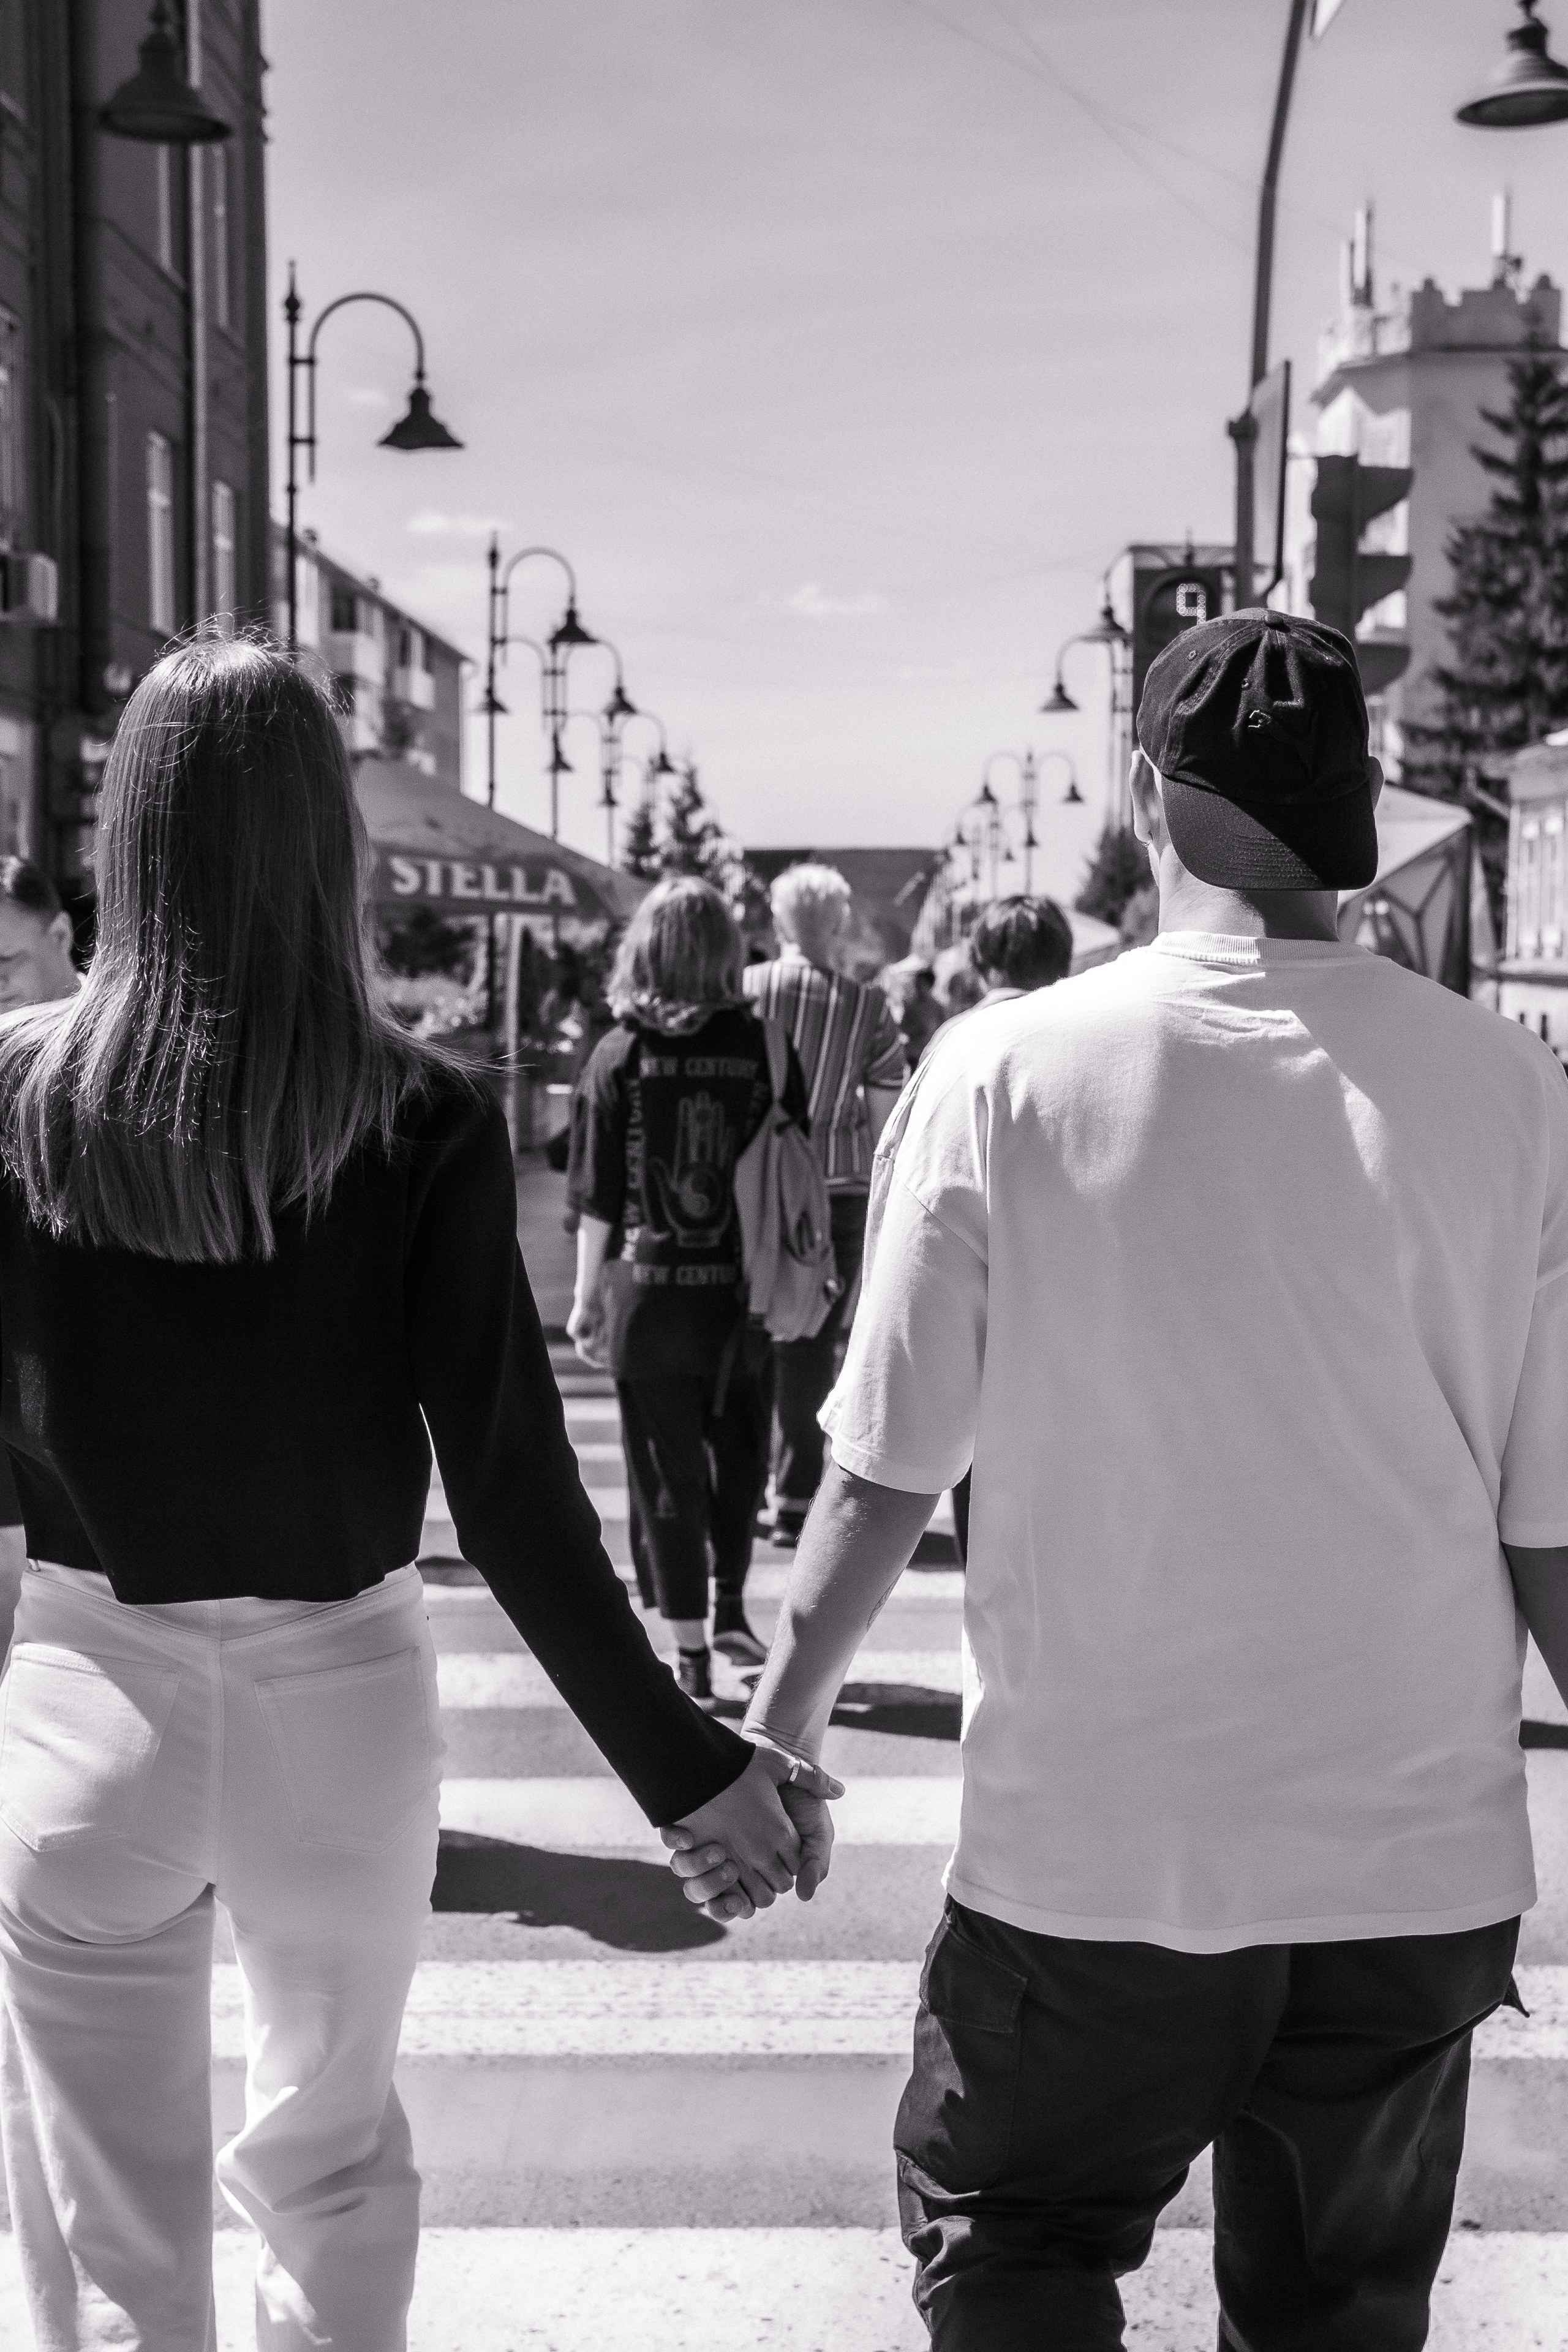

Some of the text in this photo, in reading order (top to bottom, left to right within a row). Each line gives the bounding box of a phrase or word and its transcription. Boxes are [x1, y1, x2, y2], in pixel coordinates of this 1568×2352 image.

[1176, 583, 1206, 624] 9
[390, 856, 576, 906] STELLA
[639, 1056, 759, 1079] NEW CENTURY
